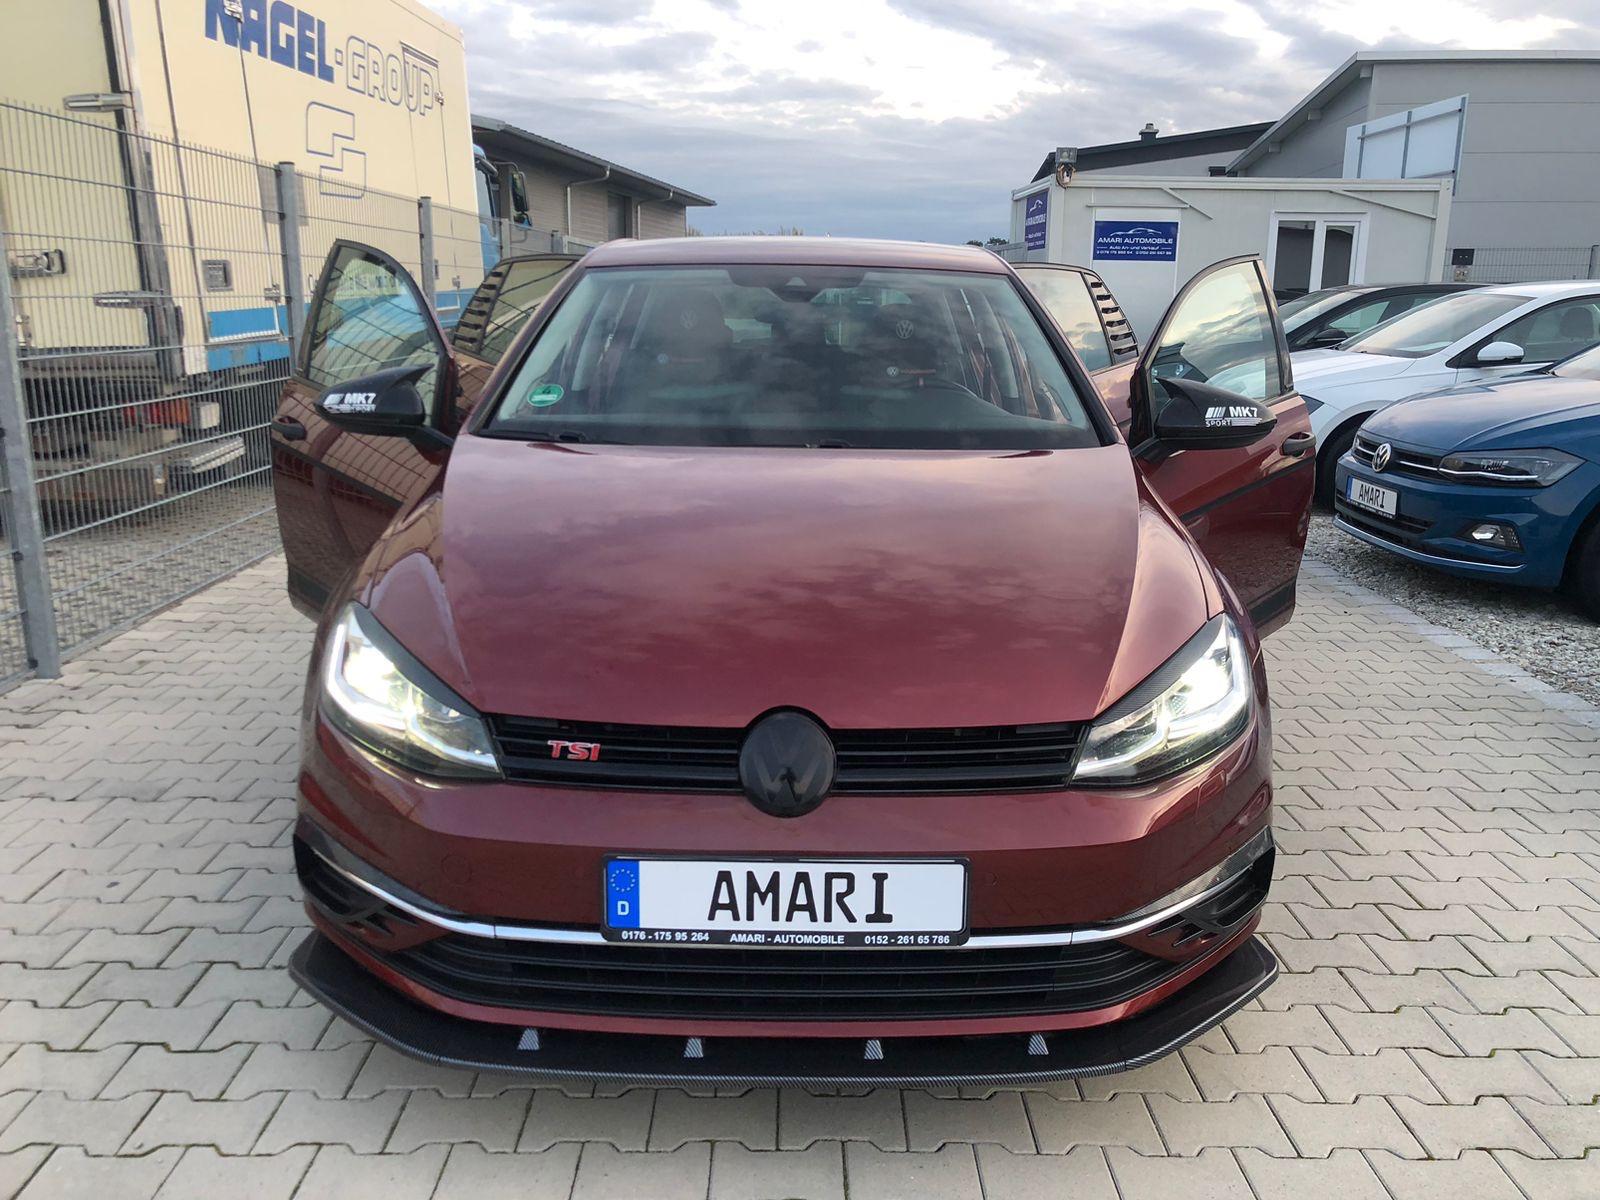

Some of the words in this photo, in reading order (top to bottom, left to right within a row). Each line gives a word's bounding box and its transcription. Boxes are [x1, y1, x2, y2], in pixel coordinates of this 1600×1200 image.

[344, 392, 377, 404] MK7
[1228, 406, 1258, 418] MK7
[1205, 420, 1231, 428] SPORT
[1358, 483, 1386, 509] AMARI
[547, 739, 601, 762] TSI
[707, 870, 894, 923] AMARI
[617, 901, 630, 916] D
[621, 930, 646, 941] 0176
[653, 931, 672, 941] 175
[674, 931, 688, 941] 95
[690, 932, 710, 942] 264
[729, 933, 765, 943] AMARI
[773, 934, 845, 944] AUTOMOBILE
[864, 935, 889, 944] 0152
[897, 935, 915, 944] 261
[917, 935, 930, 944] 65
[932, 935, 950, 944] 786
